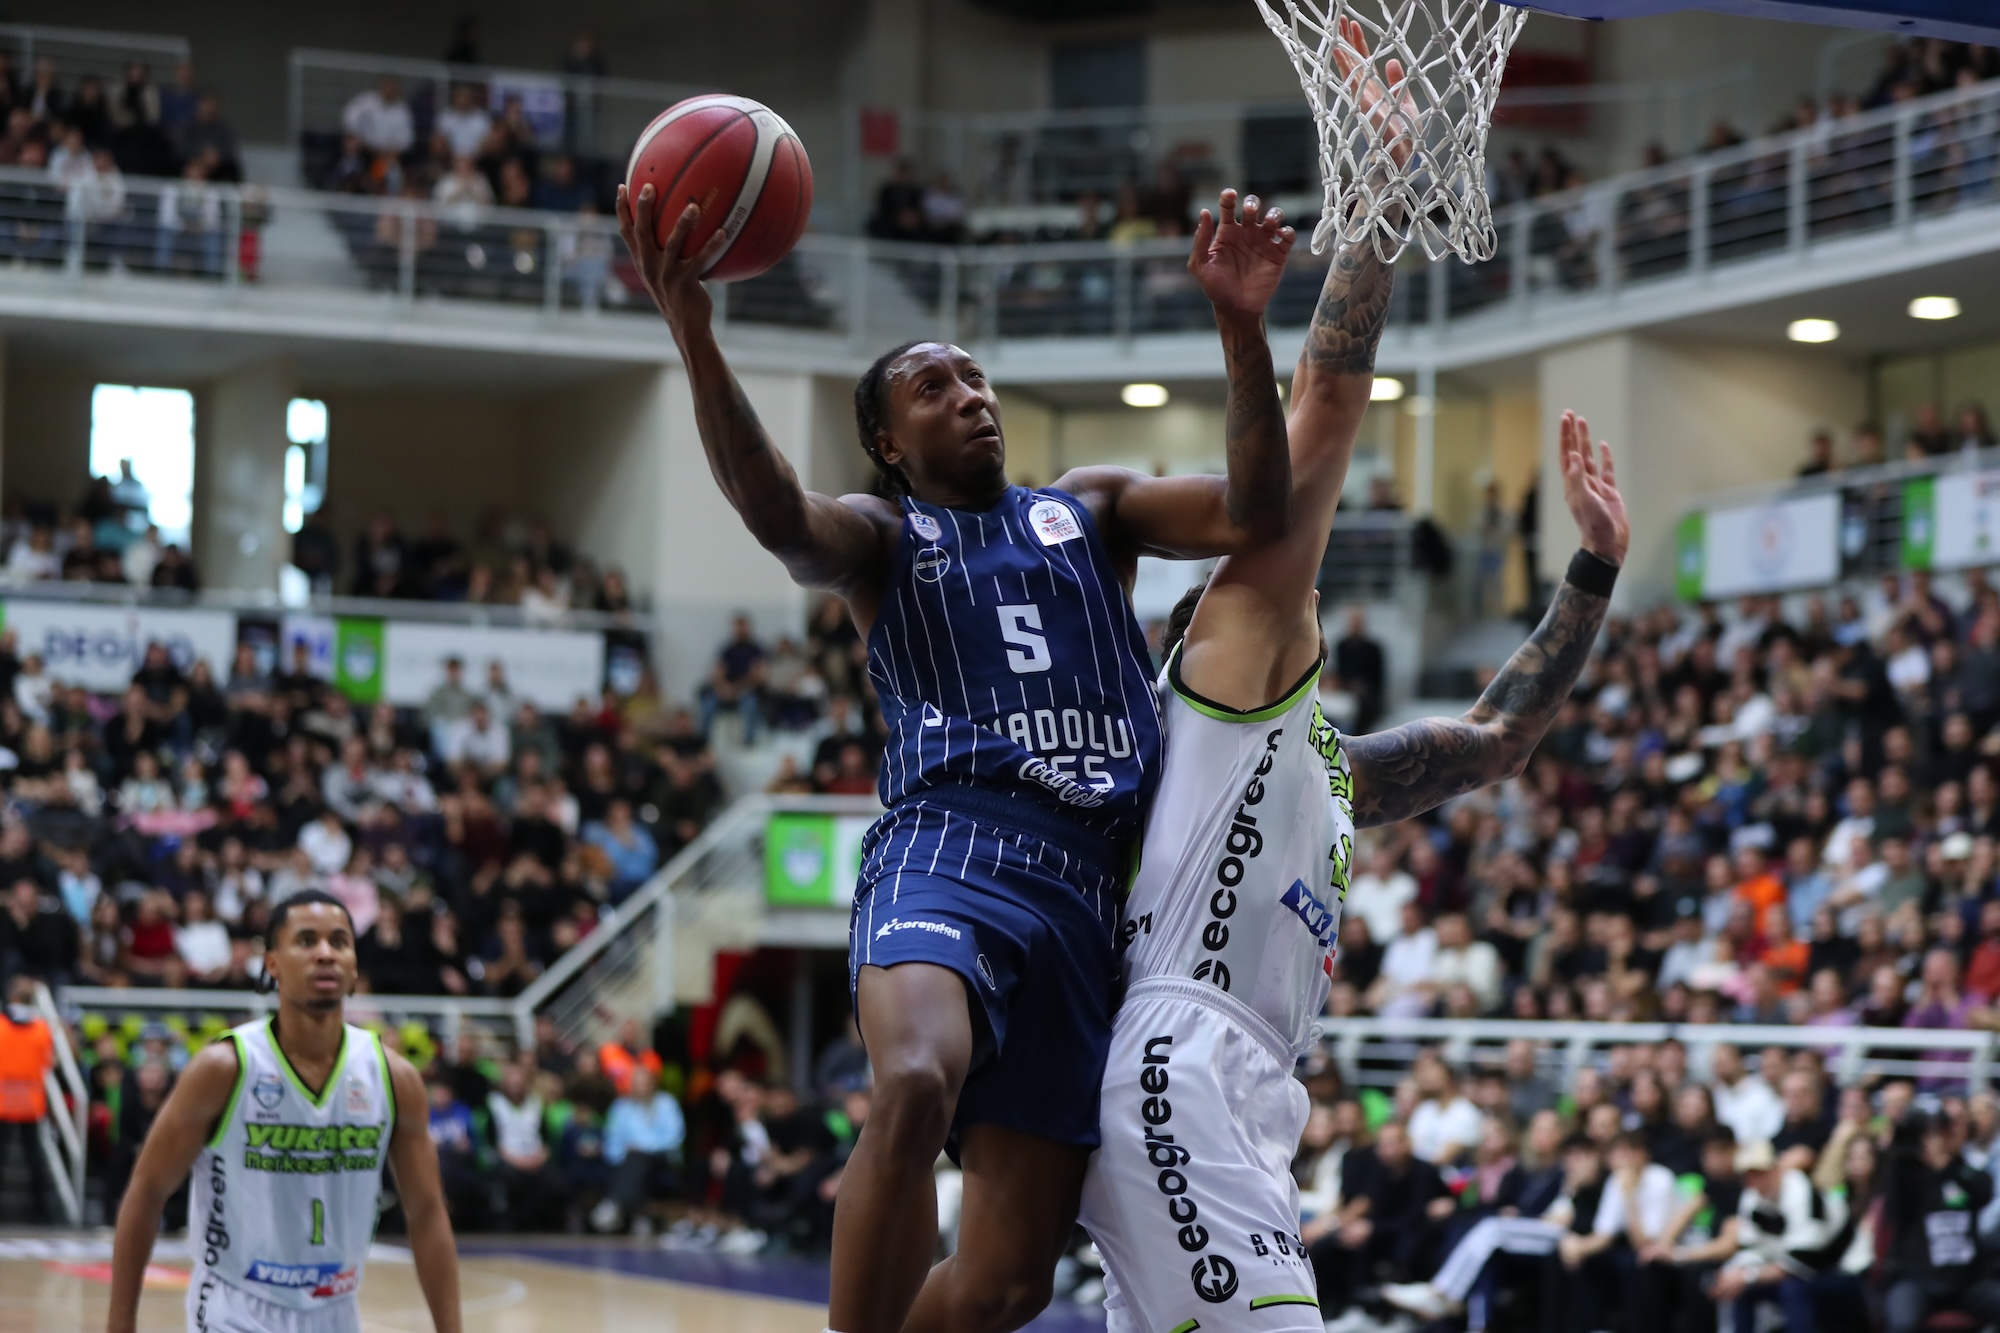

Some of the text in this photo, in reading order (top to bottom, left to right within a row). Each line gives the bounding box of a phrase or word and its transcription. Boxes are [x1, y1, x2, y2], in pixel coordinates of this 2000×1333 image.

[916, 558, 947, 570] GSA
[995, 603, 1052, 674] 5
[922, 701, 1131, 758] ADOLU
[1202, 728, 1283, 952] ecogreen
[894, 920, 962, 941] corendon
[1140, 1035, 1210, 1252] ecogreen
[205, 1154, 230, 1267] ogreen
[310, 1198, 325, 1246] 1
